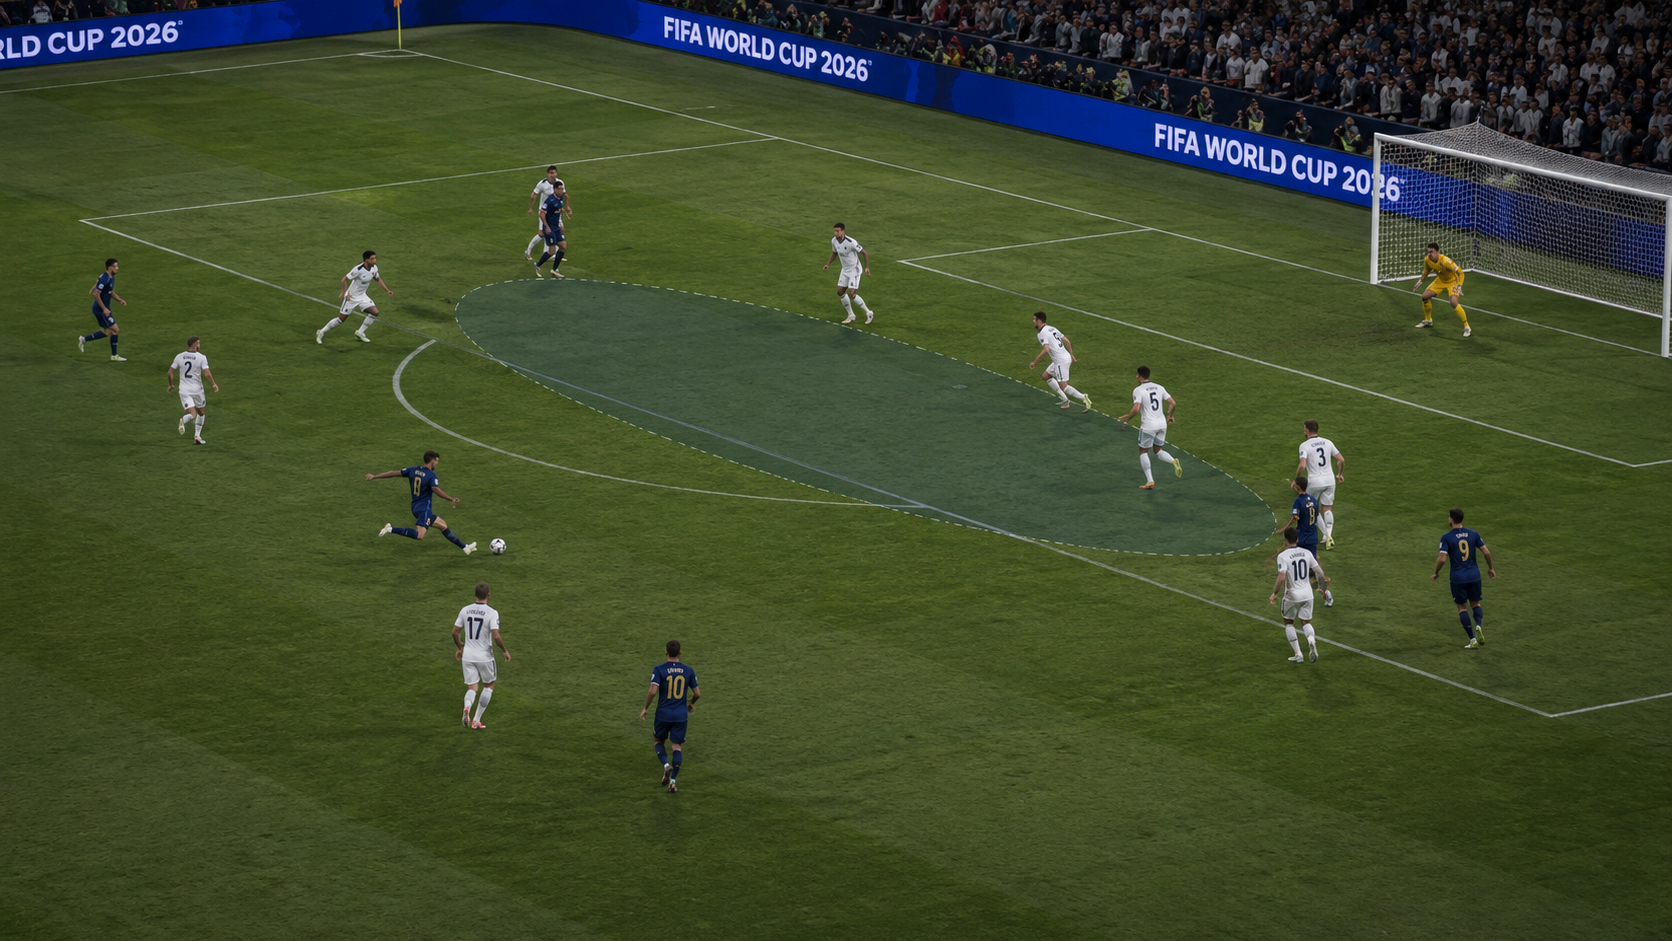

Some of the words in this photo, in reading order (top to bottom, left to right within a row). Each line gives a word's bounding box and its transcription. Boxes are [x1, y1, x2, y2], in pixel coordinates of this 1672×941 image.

[0, 35, 41, 60] LD
[47, 28, 105, 55] CUP
[110, 20, 180, 49] 2026
[663, 15, 703, 46] FIFA
[706, 25, 775, 61] WORLD
[778, 41, 817, 70] CUP
[820, 50, 869, 82] 2026
[1154, 122, 1200, 157] FIFA
[1205, 133, 1287, 175] WORLD
[1291, 154, 1338, 187] CUP
[184, 361, 193, 379] 2
[1149, 391, 1159, 412] 5
[1316, 447, 1326, 467] 3
[1458, 539, 1470, 562] 9
[1291, 558, 1308, 582] 10
[466, 616, 484, 640] 17
[666, 675, 686, 700] 10
